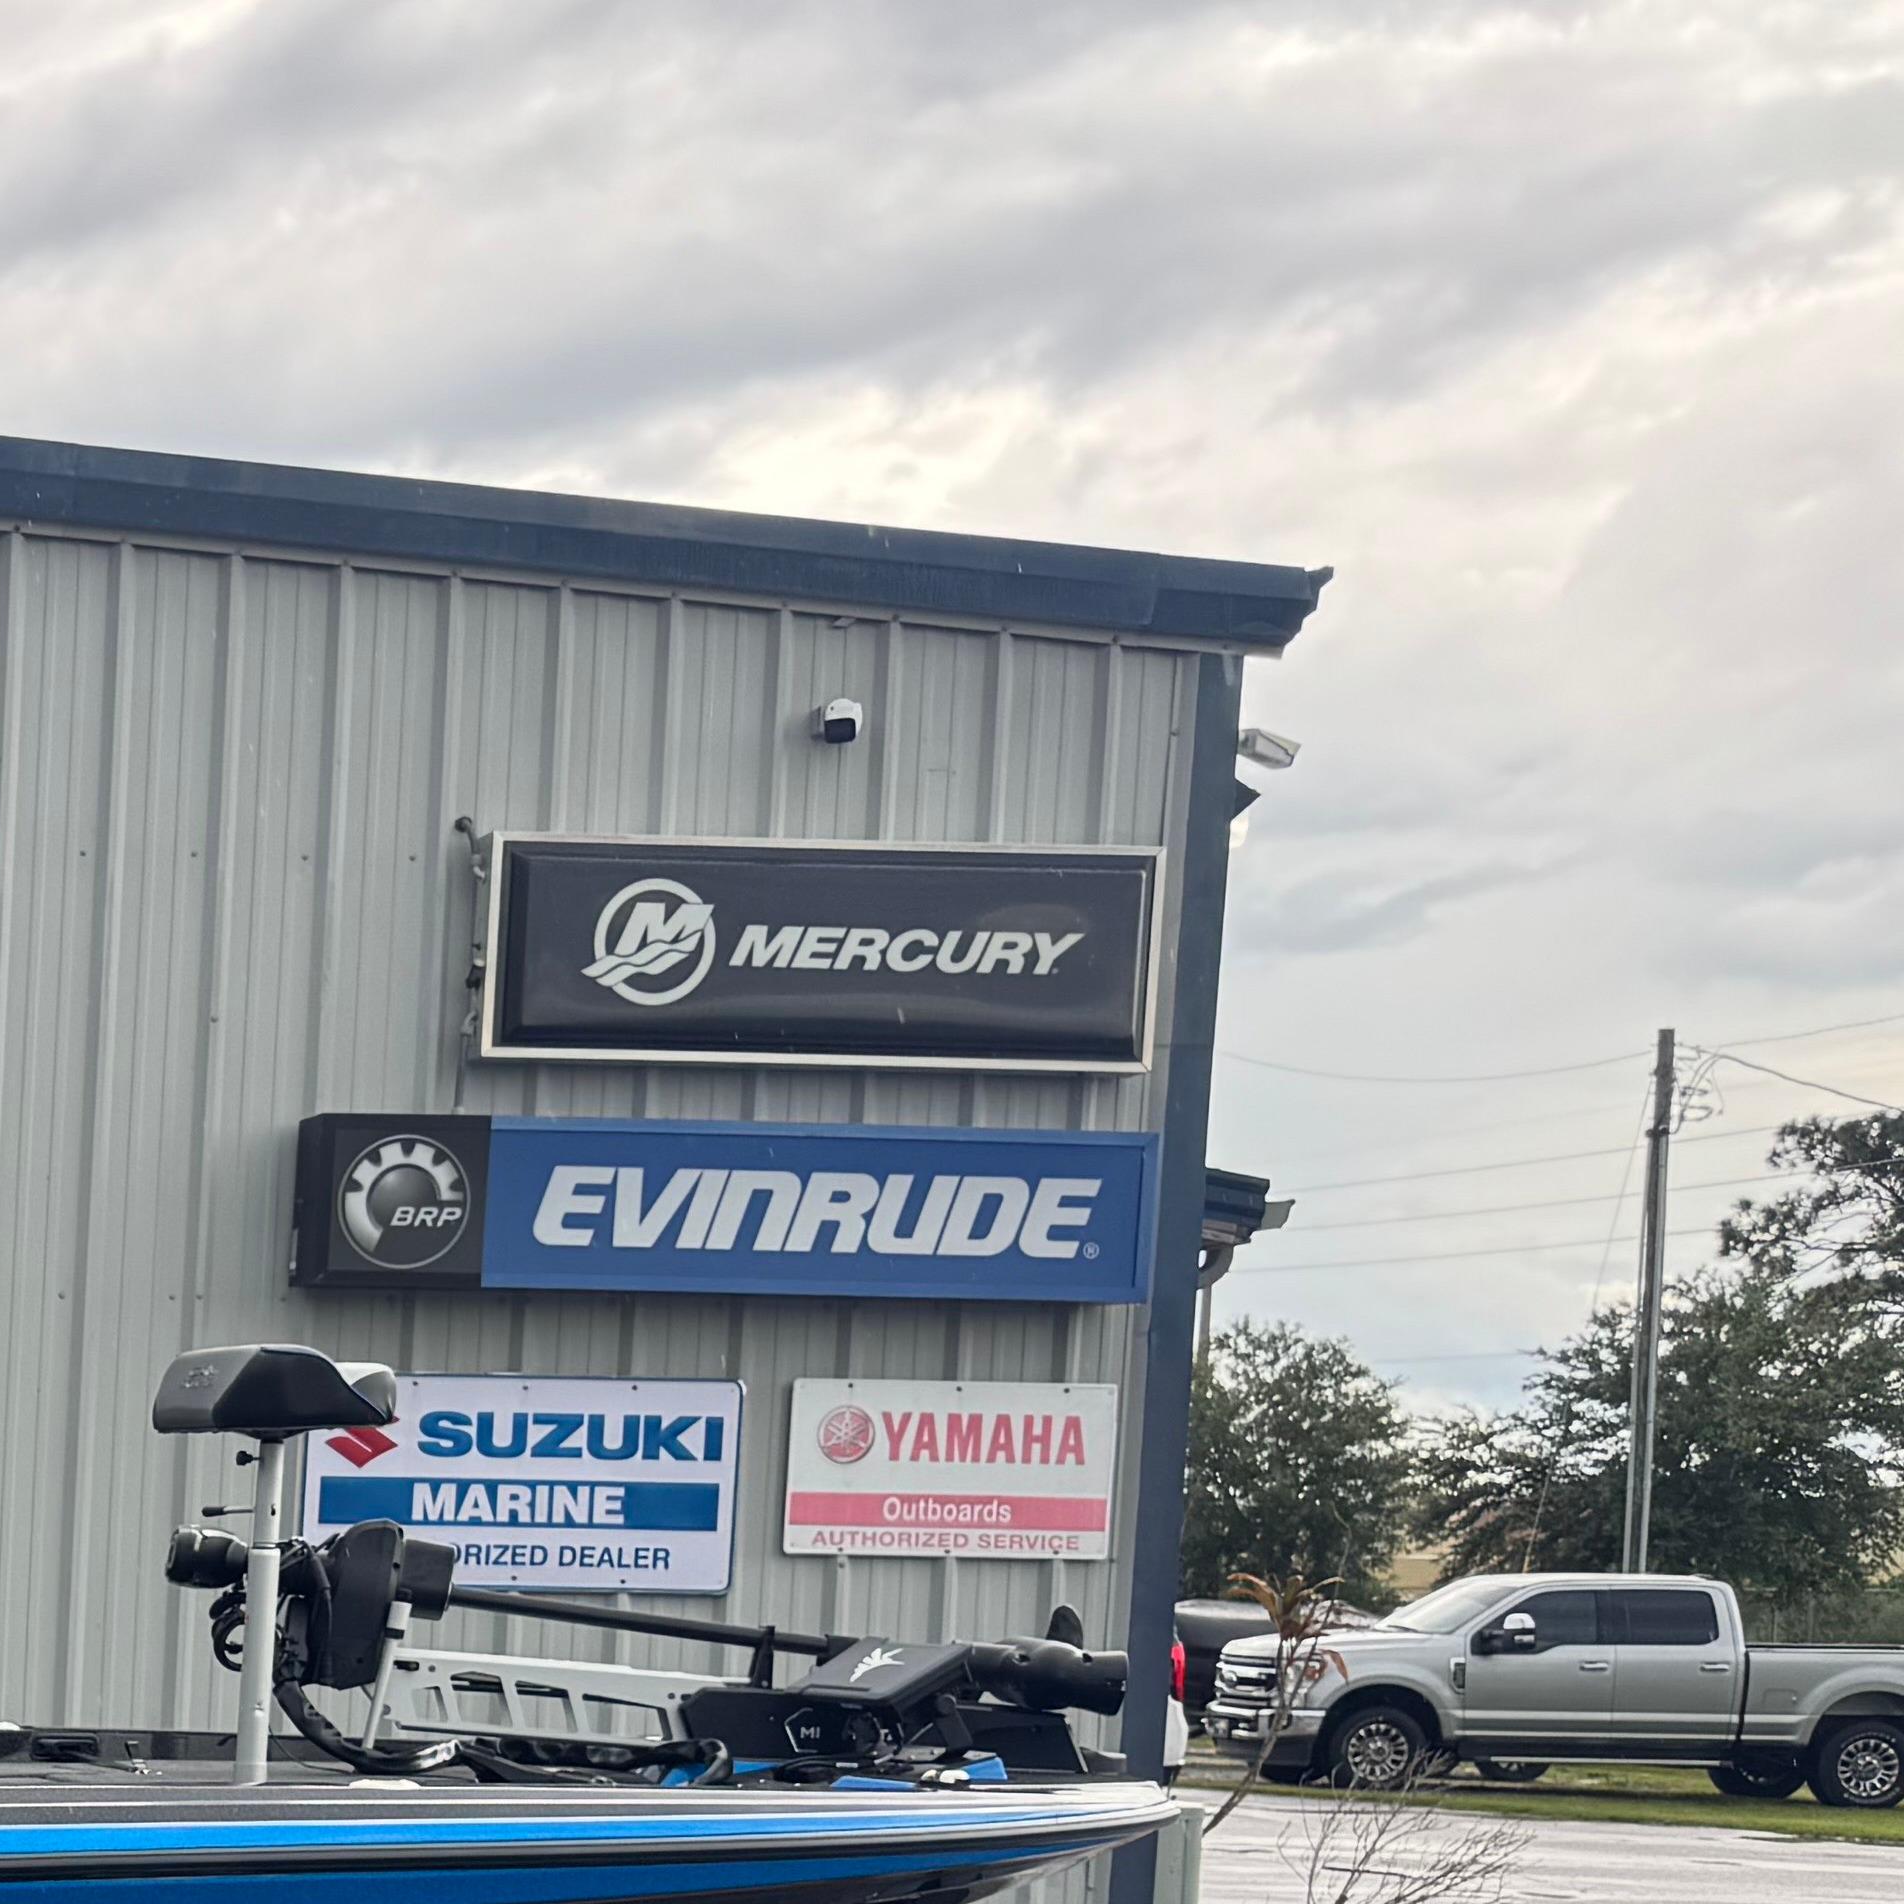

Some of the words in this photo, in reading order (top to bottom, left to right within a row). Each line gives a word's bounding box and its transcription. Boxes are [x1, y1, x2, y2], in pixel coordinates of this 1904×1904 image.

[729, 925, 1085, 975] MERCURY
[390, 1208, 462, 1227] BRP
[417, 1411, 724, 1461] SUZUKI
[882, 1411, 1085, 1465] YAMAHA
[411, 1482, 625, 1525] MARINE
[883, 1497, 1011, 1522] Outboards
[454, 1543, 548, 1567] RIZED
[558, 1544, 670, 1570] DEALER
[812, 1530, 968, 1548] AUTHORIZED
[978, 1534, 1079, 1550] SERVICE
